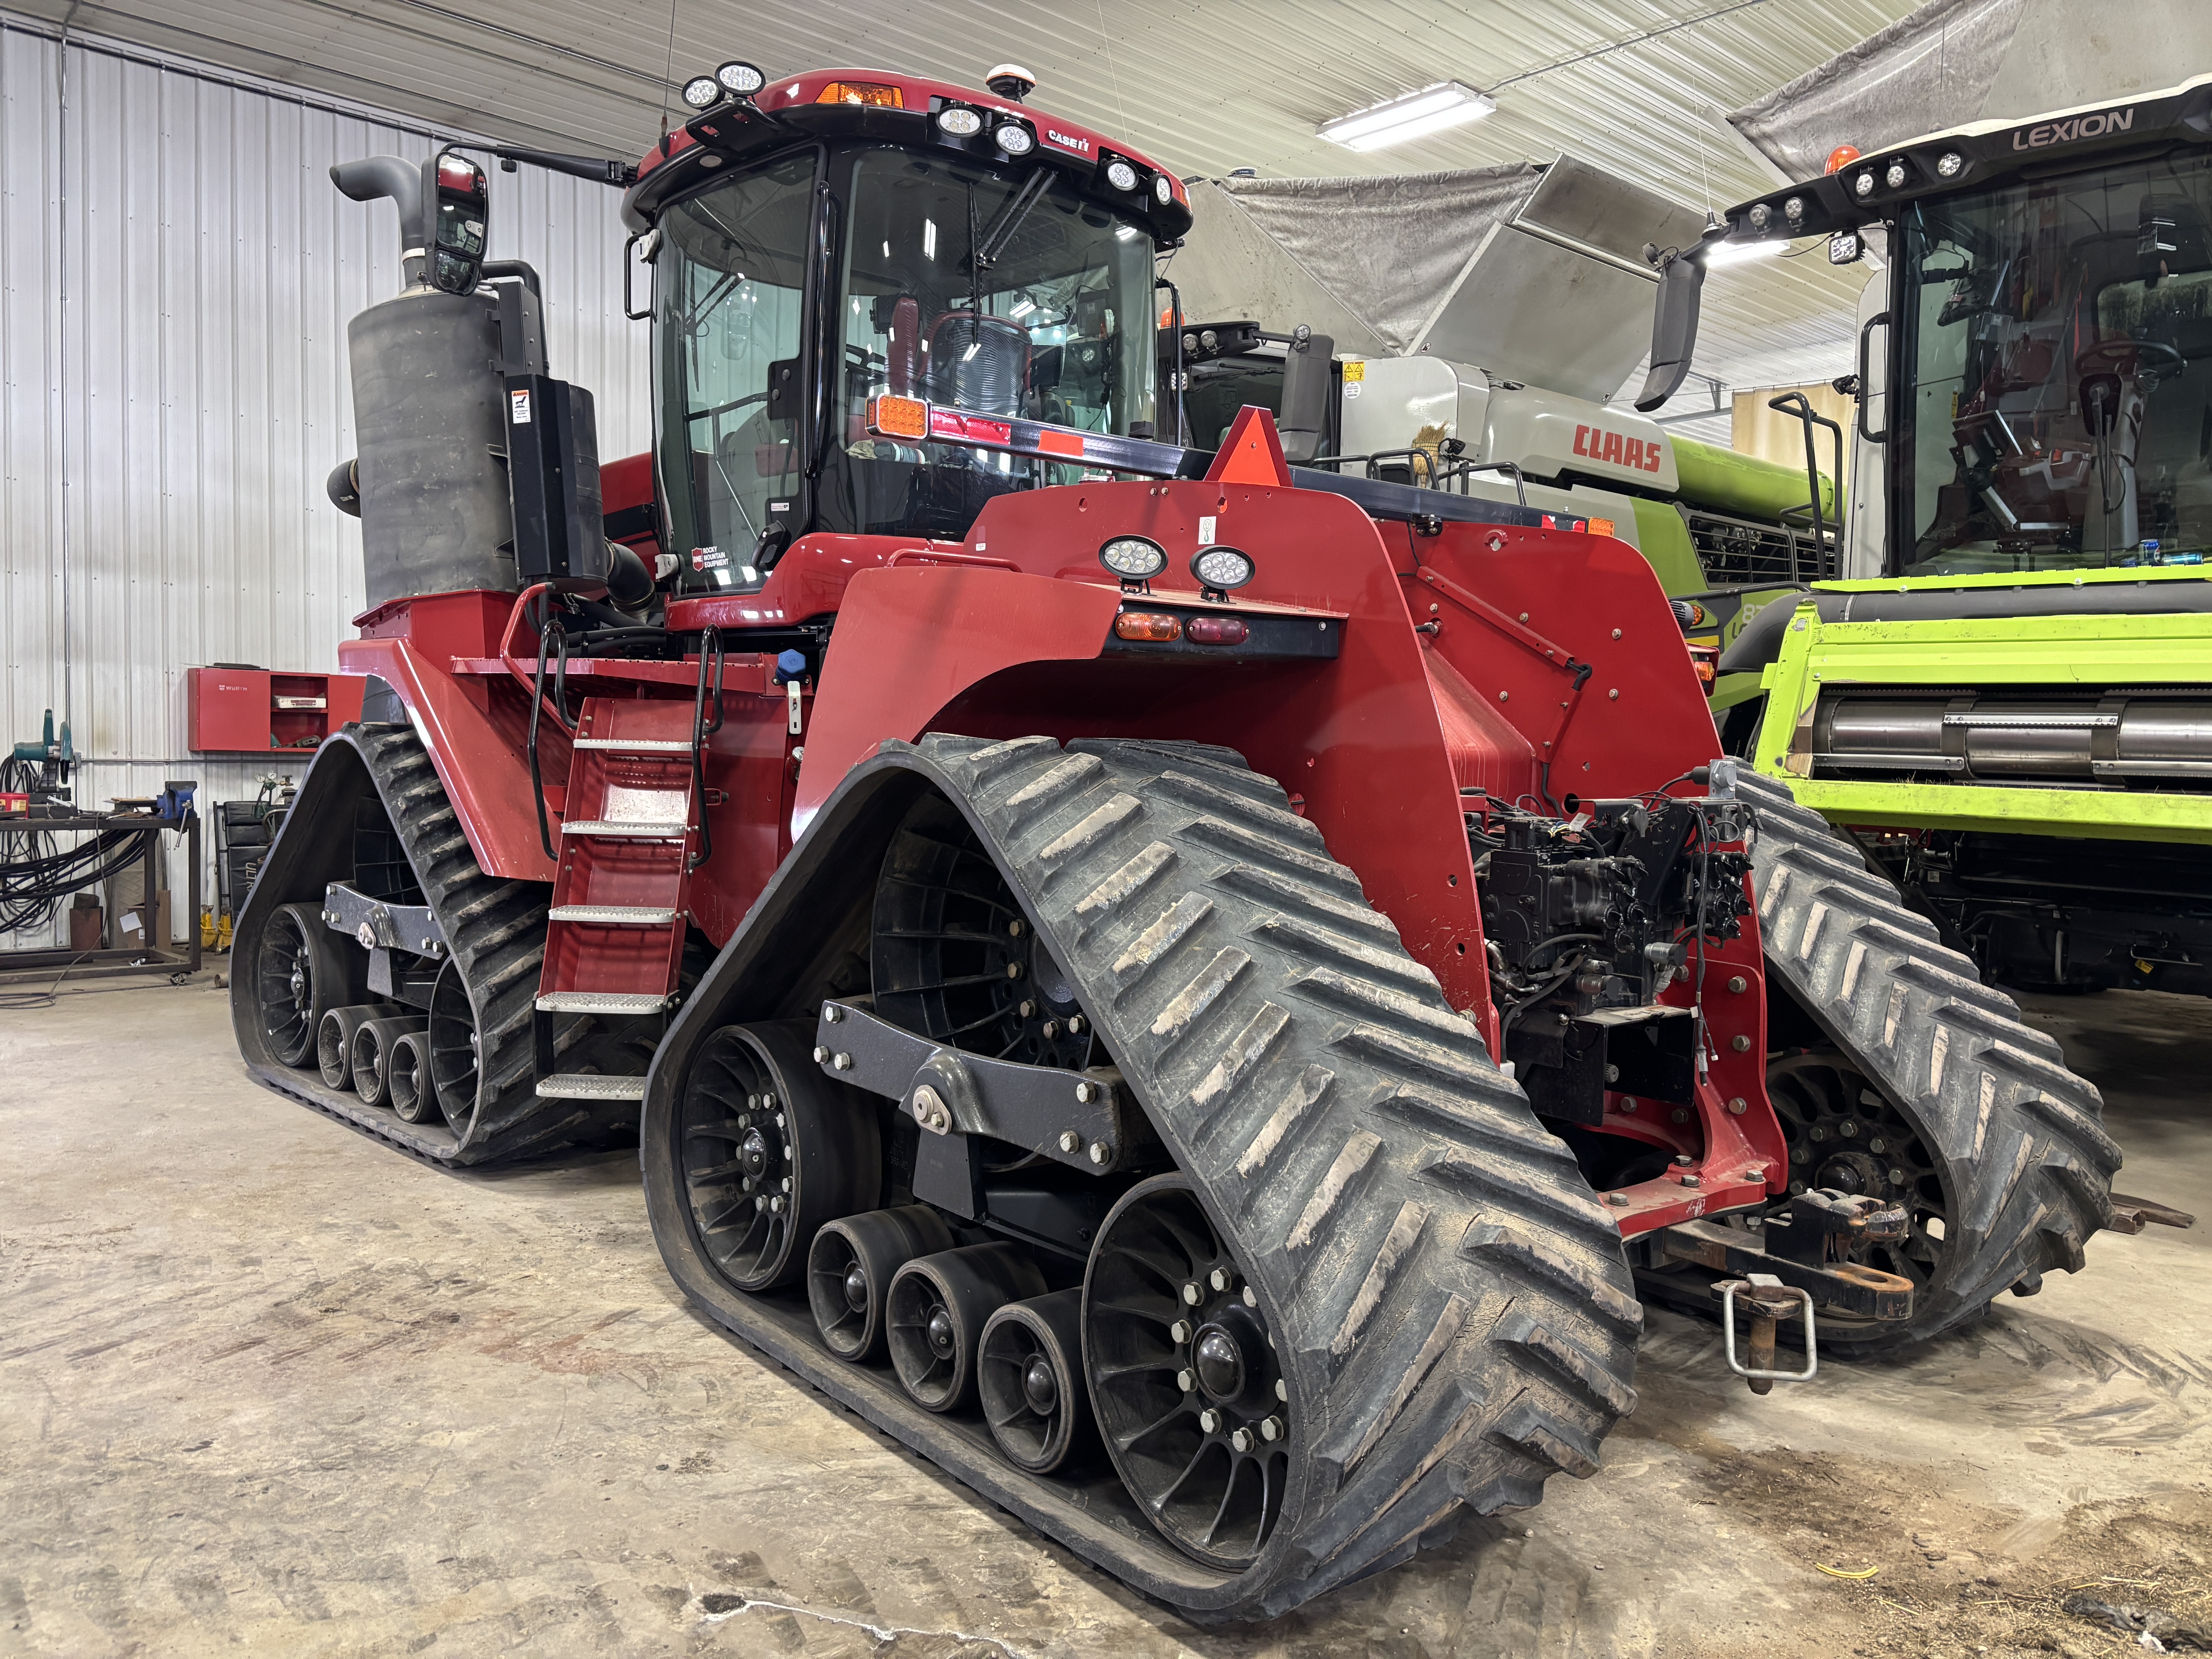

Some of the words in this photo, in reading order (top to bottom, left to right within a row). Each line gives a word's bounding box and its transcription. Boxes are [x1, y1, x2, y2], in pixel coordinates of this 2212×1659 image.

[1049, 130, 1077, 148] CASE
[2013, 108, 2134, 150] LEXION
[1573, 424, 1661, 473] CLAAS
[704, 552, 725, 561] MOUNTAIN
[704, 558, 728, 568] EQUIPMENT
[246, 862, 256, 891] ULTR
